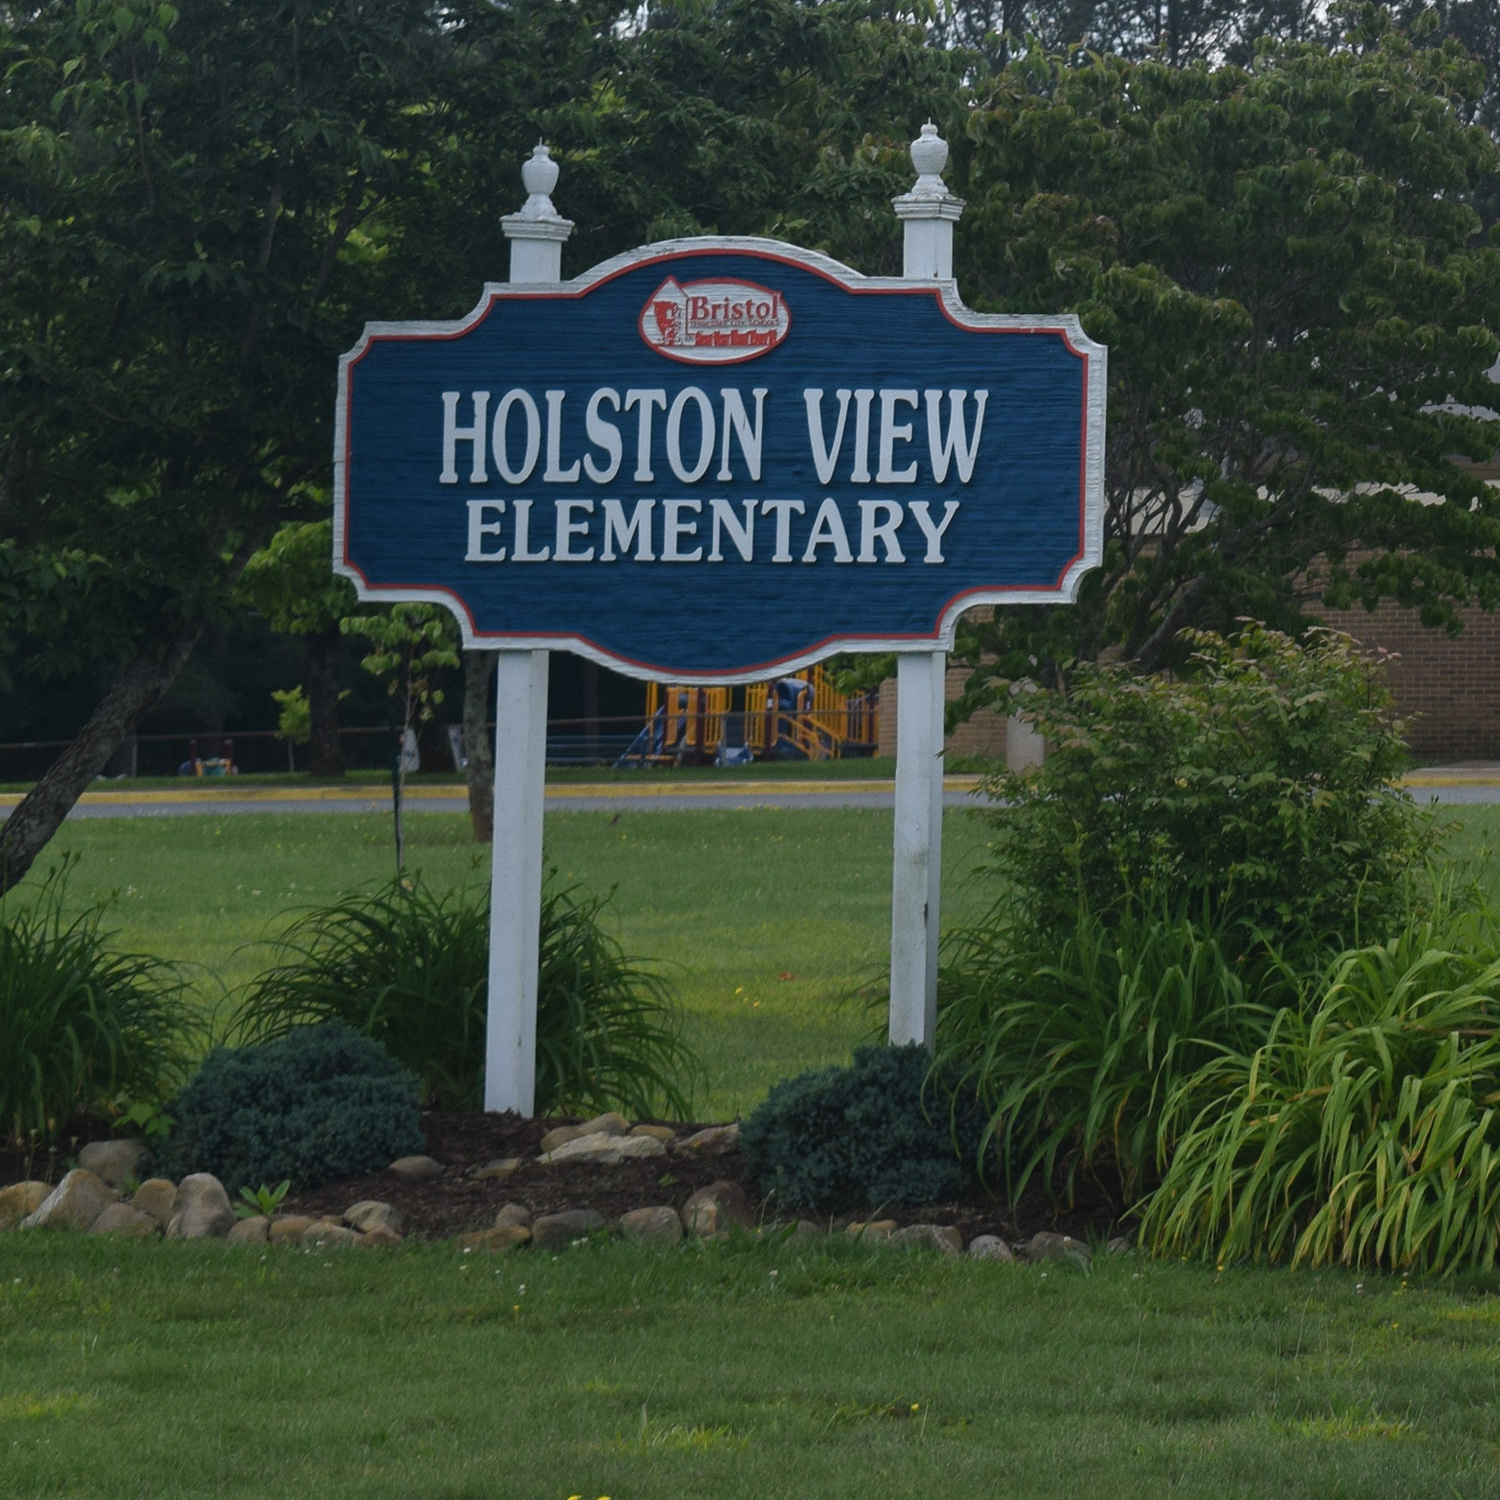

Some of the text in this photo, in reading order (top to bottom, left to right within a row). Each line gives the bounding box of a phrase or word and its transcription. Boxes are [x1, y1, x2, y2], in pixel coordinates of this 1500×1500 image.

[690, 294, 778, 319] Bristol
[438, 386, 990, 485] HOLSTON VIEW
[464, 497, 960, 564] ELEMENTARY
